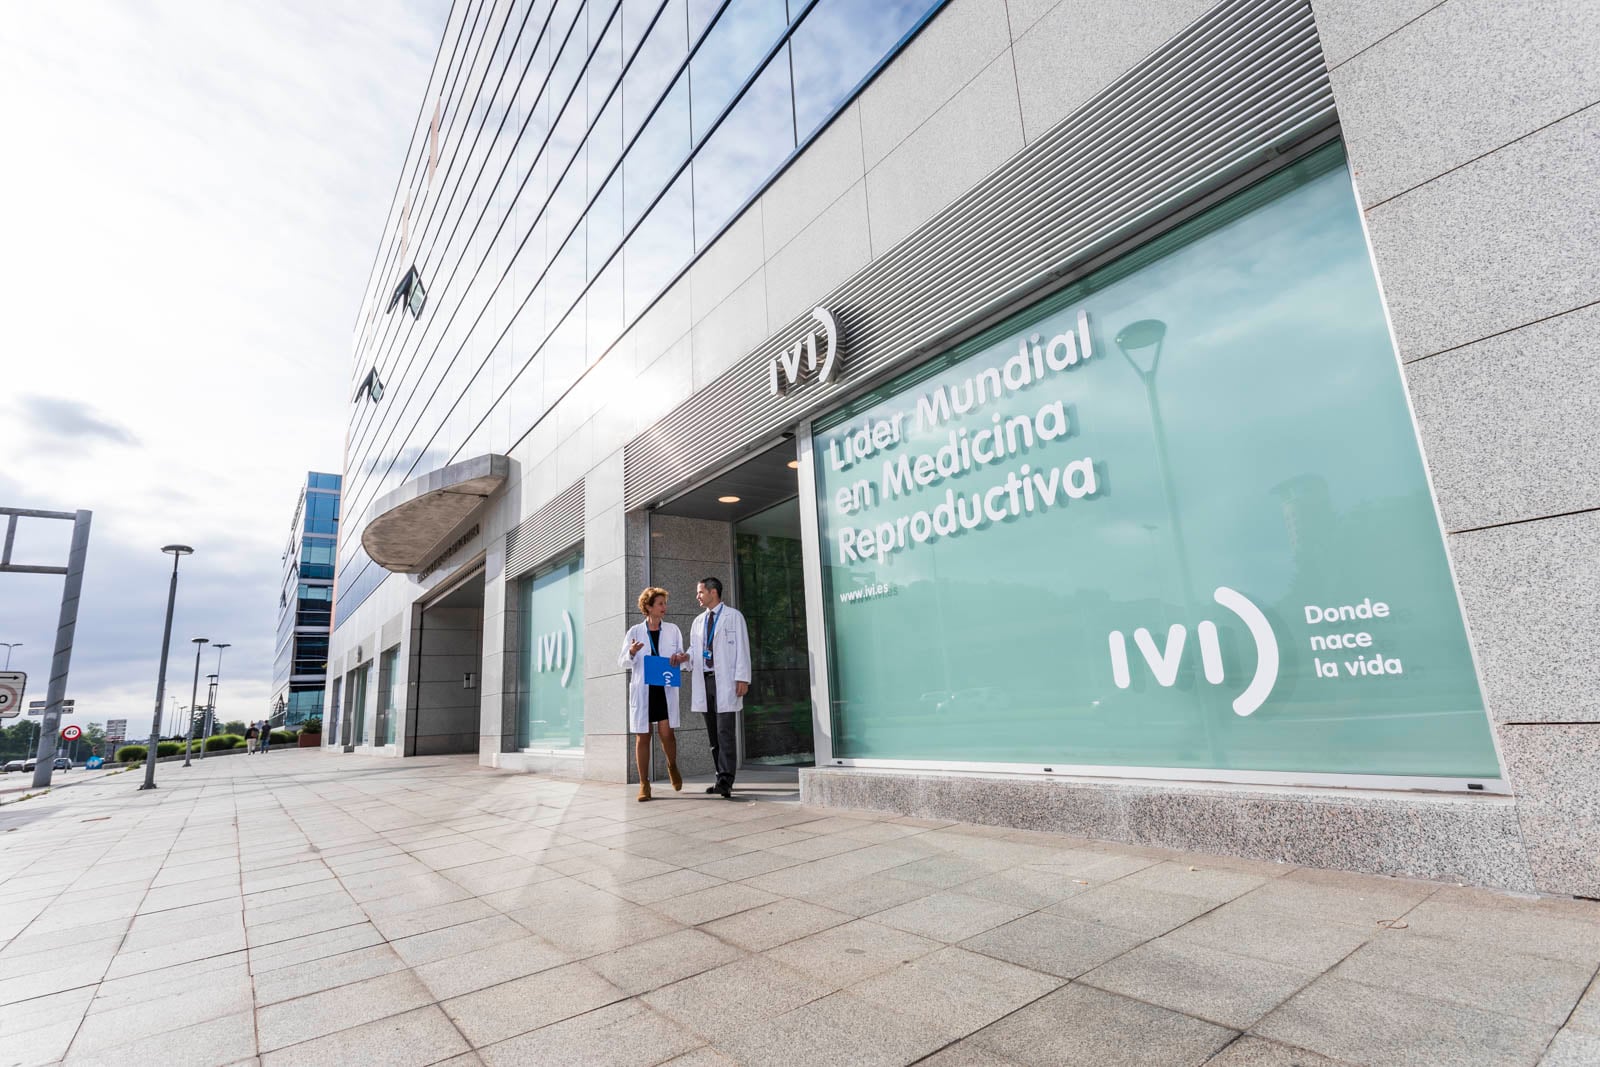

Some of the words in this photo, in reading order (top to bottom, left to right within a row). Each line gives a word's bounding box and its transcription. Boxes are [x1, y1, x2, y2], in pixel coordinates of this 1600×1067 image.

[915, 309, 1093, 427] Mundial
[835, 479, 871, 515] en
[882, 400, 1067, 499] Medicina
[838, 456, 1097, 565] Reproductiva
[839, 583, 889, 603] www.ivi.es
[1304, 598, 1390, 624] Donde
[1310, 631, 1373, 651] nace
[1314, 658, 1339, 678] la
[1344, 654, 1403, 677] vida
